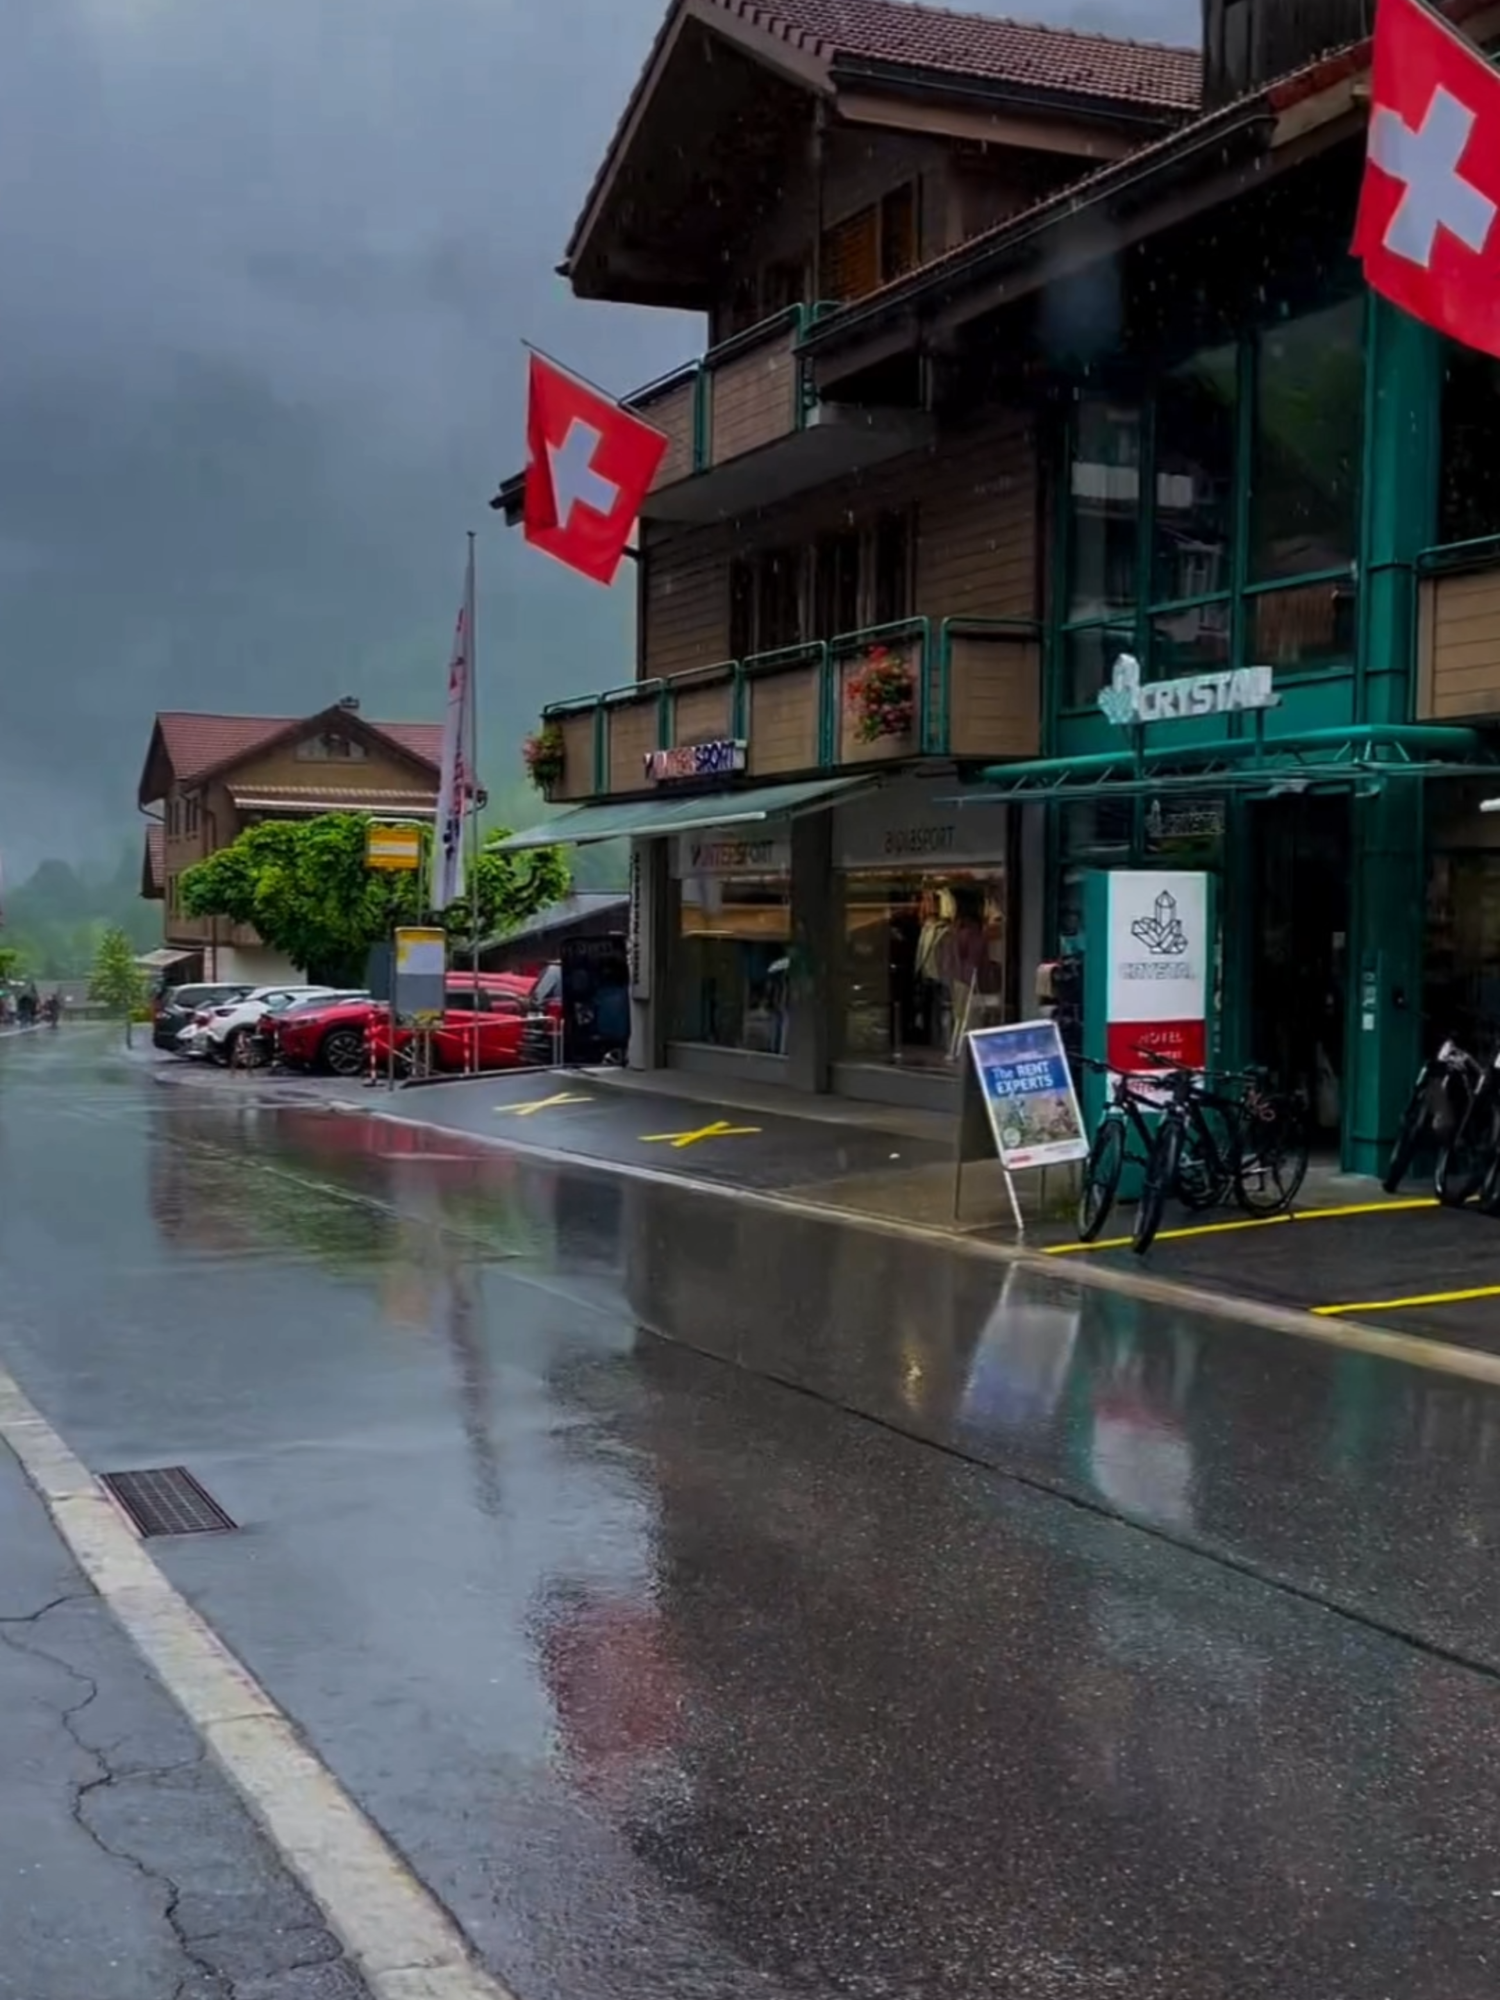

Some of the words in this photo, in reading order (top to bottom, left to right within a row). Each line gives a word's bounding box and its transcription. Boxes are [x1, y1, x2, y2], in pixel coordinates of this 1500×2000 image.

[1139, 667, 1273, 720] CRYSTAL
[992, 1067, 1014, 1079] The
[1016, 1061, 1050, 1077] RENT
[996, 1075, 1054, 1094] EXPERTS
